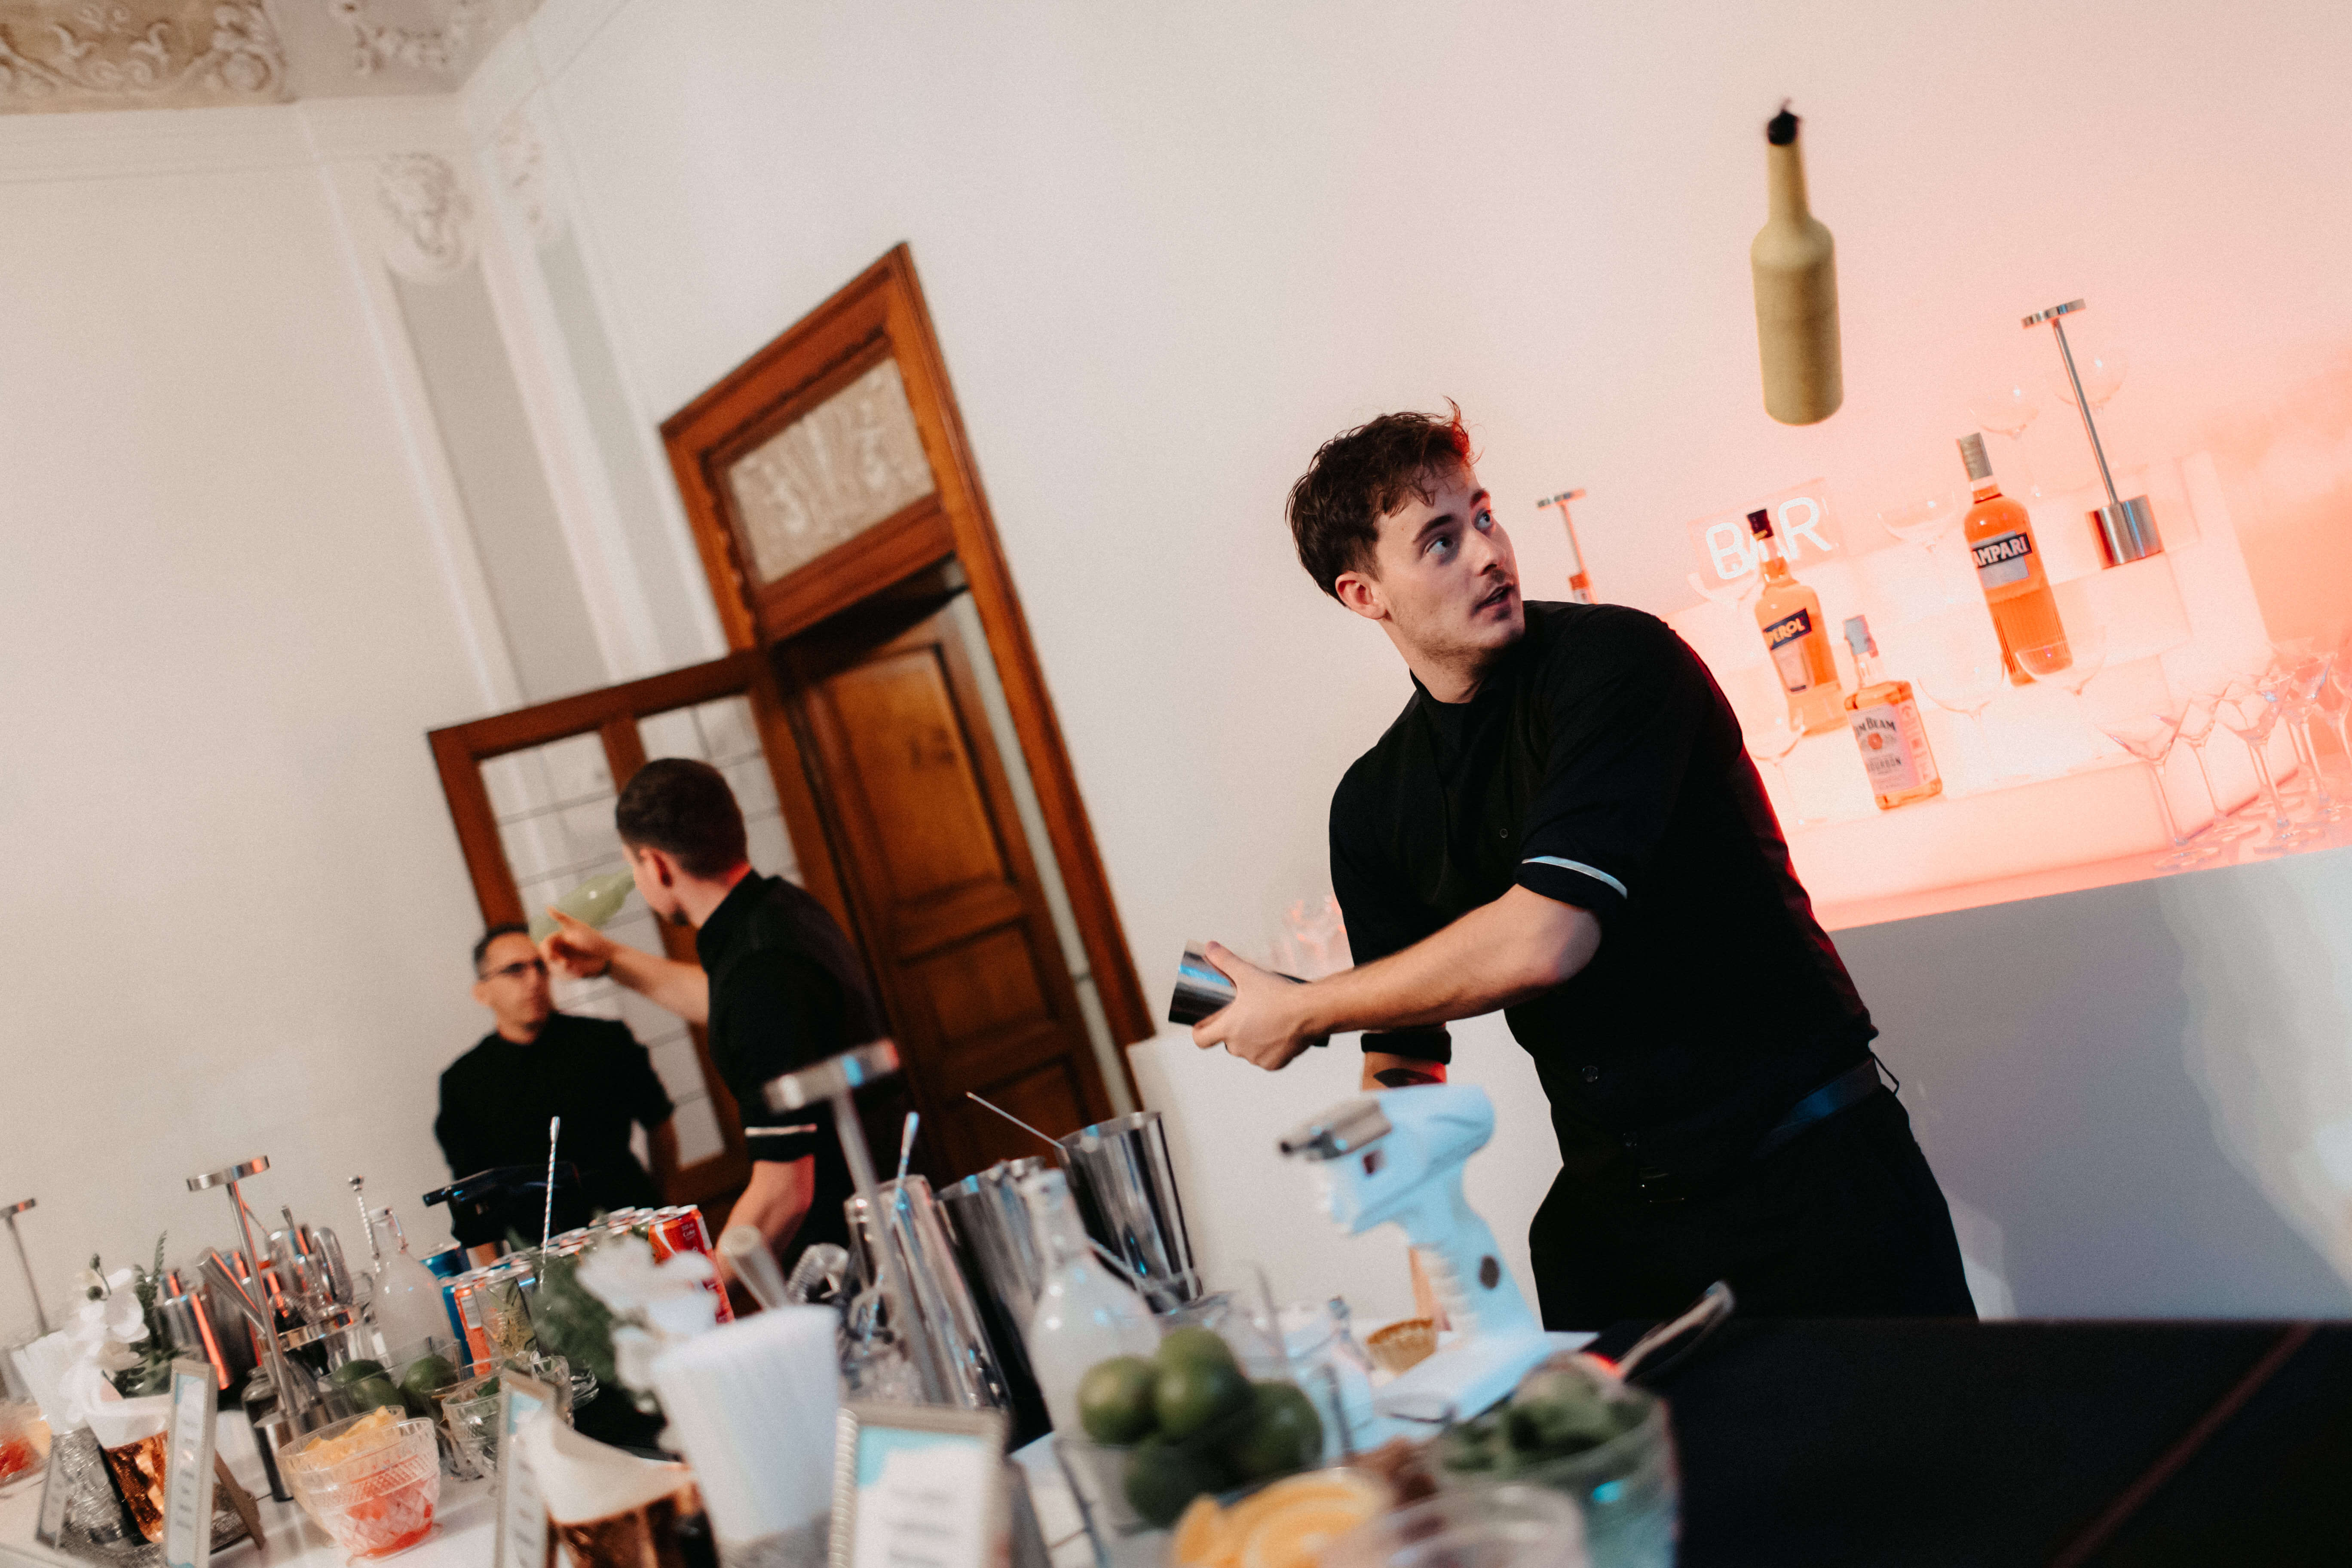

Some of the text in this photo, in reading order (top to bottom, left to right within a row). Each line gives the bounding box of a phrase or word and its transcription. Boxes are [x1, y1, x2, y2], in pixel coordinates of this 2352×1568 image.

[1972, 536, 2028, 567] AMPARI
[1764, 618, 1806, 646] PEROL
[1865, 717, 1897, 732] BEAM
